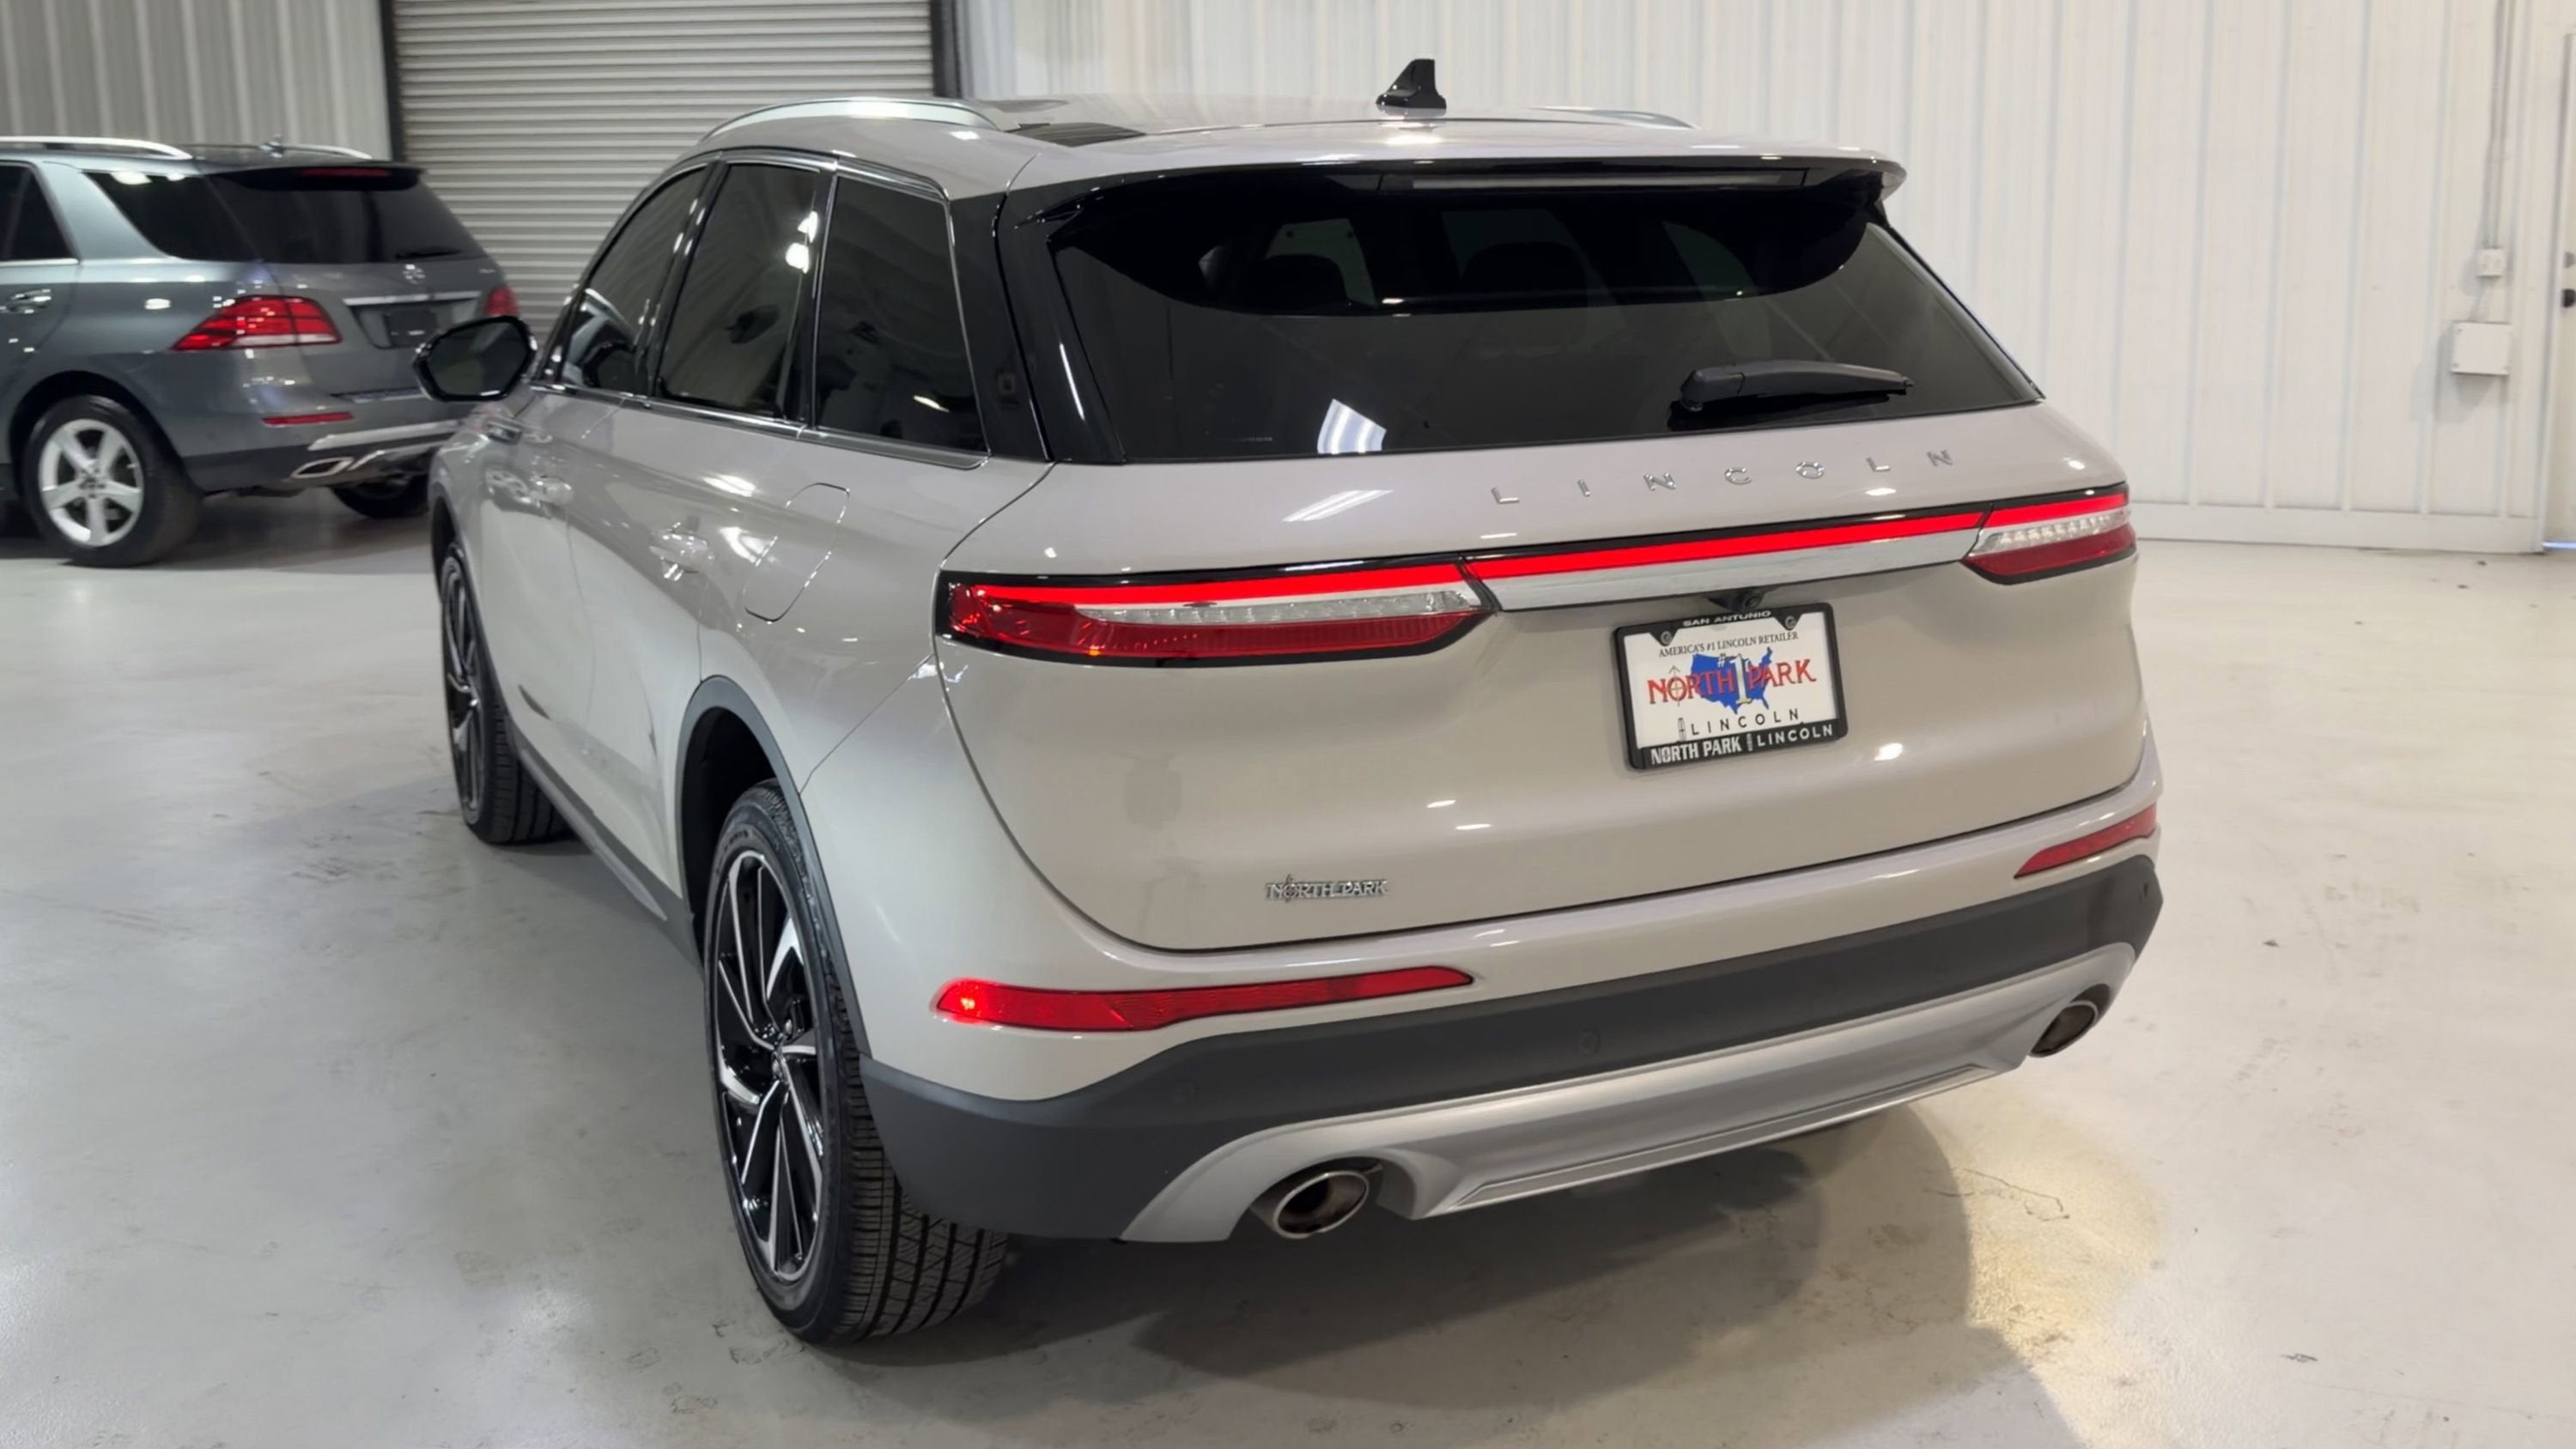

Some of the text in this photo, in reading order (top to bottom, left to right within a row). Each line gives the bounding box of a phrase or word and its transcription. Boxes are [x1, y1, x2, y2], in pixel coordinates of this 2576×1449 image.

[1491, 448, 1953, 505] LINCOLN
[1683, 610, 1772, 627] SAN ANTONIO
[1658, 631, 1799, 658] AMERICA'S #1 LINCOLN RETAILER
[1647, 658, 1817, 705] NORTH PARK
[1691, 708, 1800, 736] LINCOLN
[1650, 724, 1834, 765] NORTH PARK LINCOLN
[1267, 879, 1388, 900] NORTH PARK
